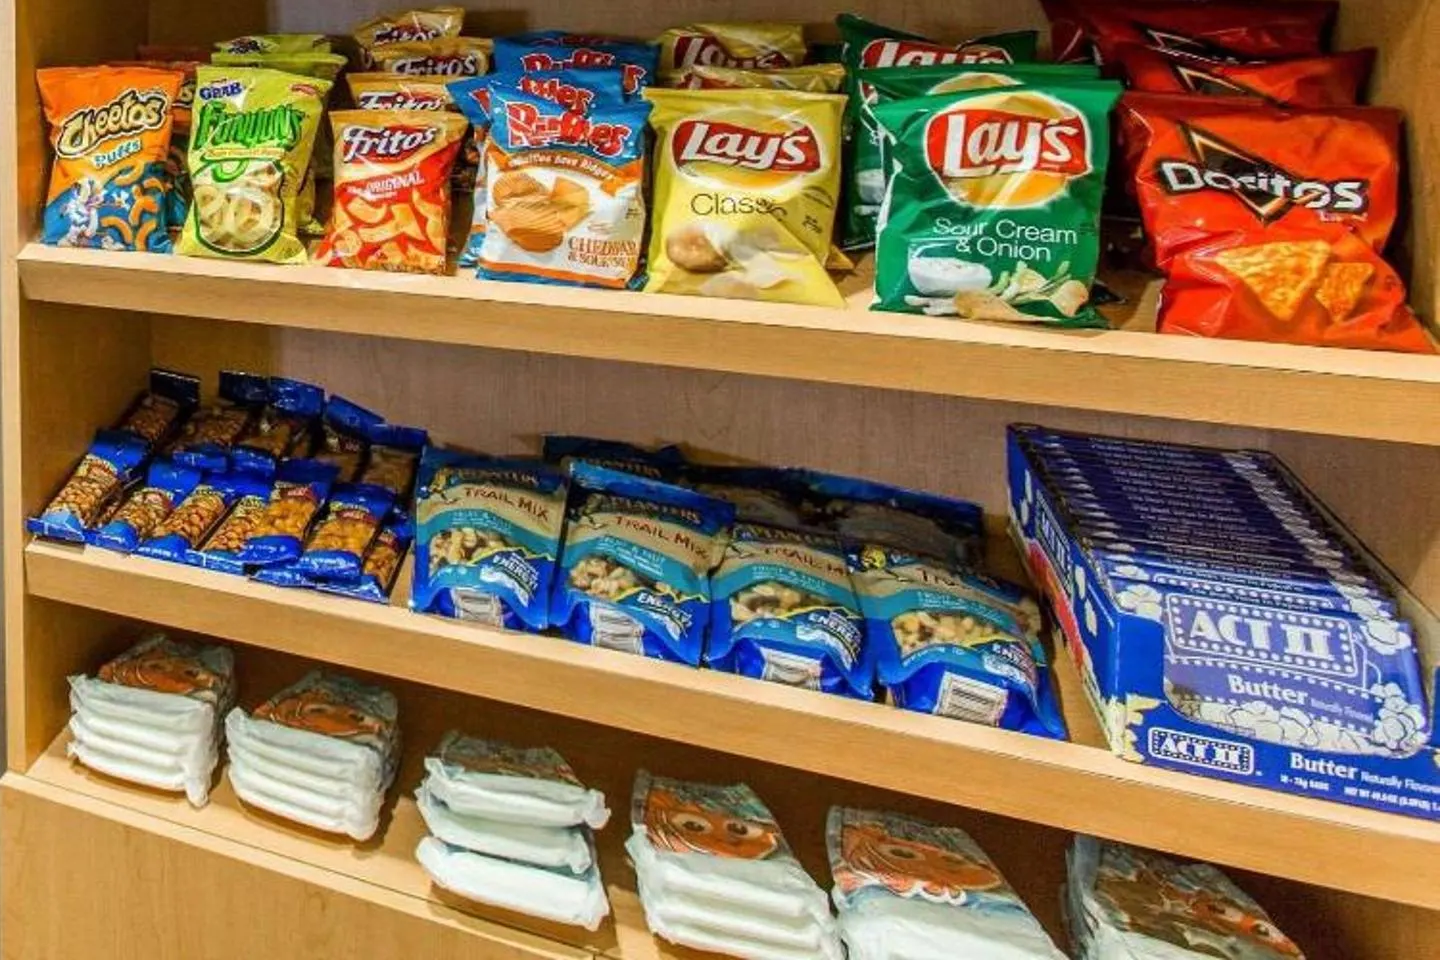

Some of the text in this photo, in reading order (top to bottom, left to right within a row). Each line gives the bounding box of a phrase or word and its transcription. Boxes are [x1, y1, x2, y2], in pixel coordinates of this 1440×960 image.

[199, 83, 245, 100] GRAB
[59, 90, 165, 154] Cheetos
[94, 140, 141, 167] Puffs
[344, 124, 438, 164] Fritos
[681, 121, 811, 172] Lay's
[943, 112, 1080, 178] Lay's
[1160, 160, 1366, 210] Doritos
[932, 216, 1078, 245] Sour Cream
[955, 236, 1051, 262] & Onion
[463, 486, 514, 507] TRAIL
[517, 496, 549, 522] MIX
[615, 515, 709, 560] TRAIL MIX
[1190, 609, 1336, 661] ACT II
[1227, 673, 1309, 706] Butter
[1161, 736, 1241, 766] ACT II
[1289, 751, 1359, 780] Butter
